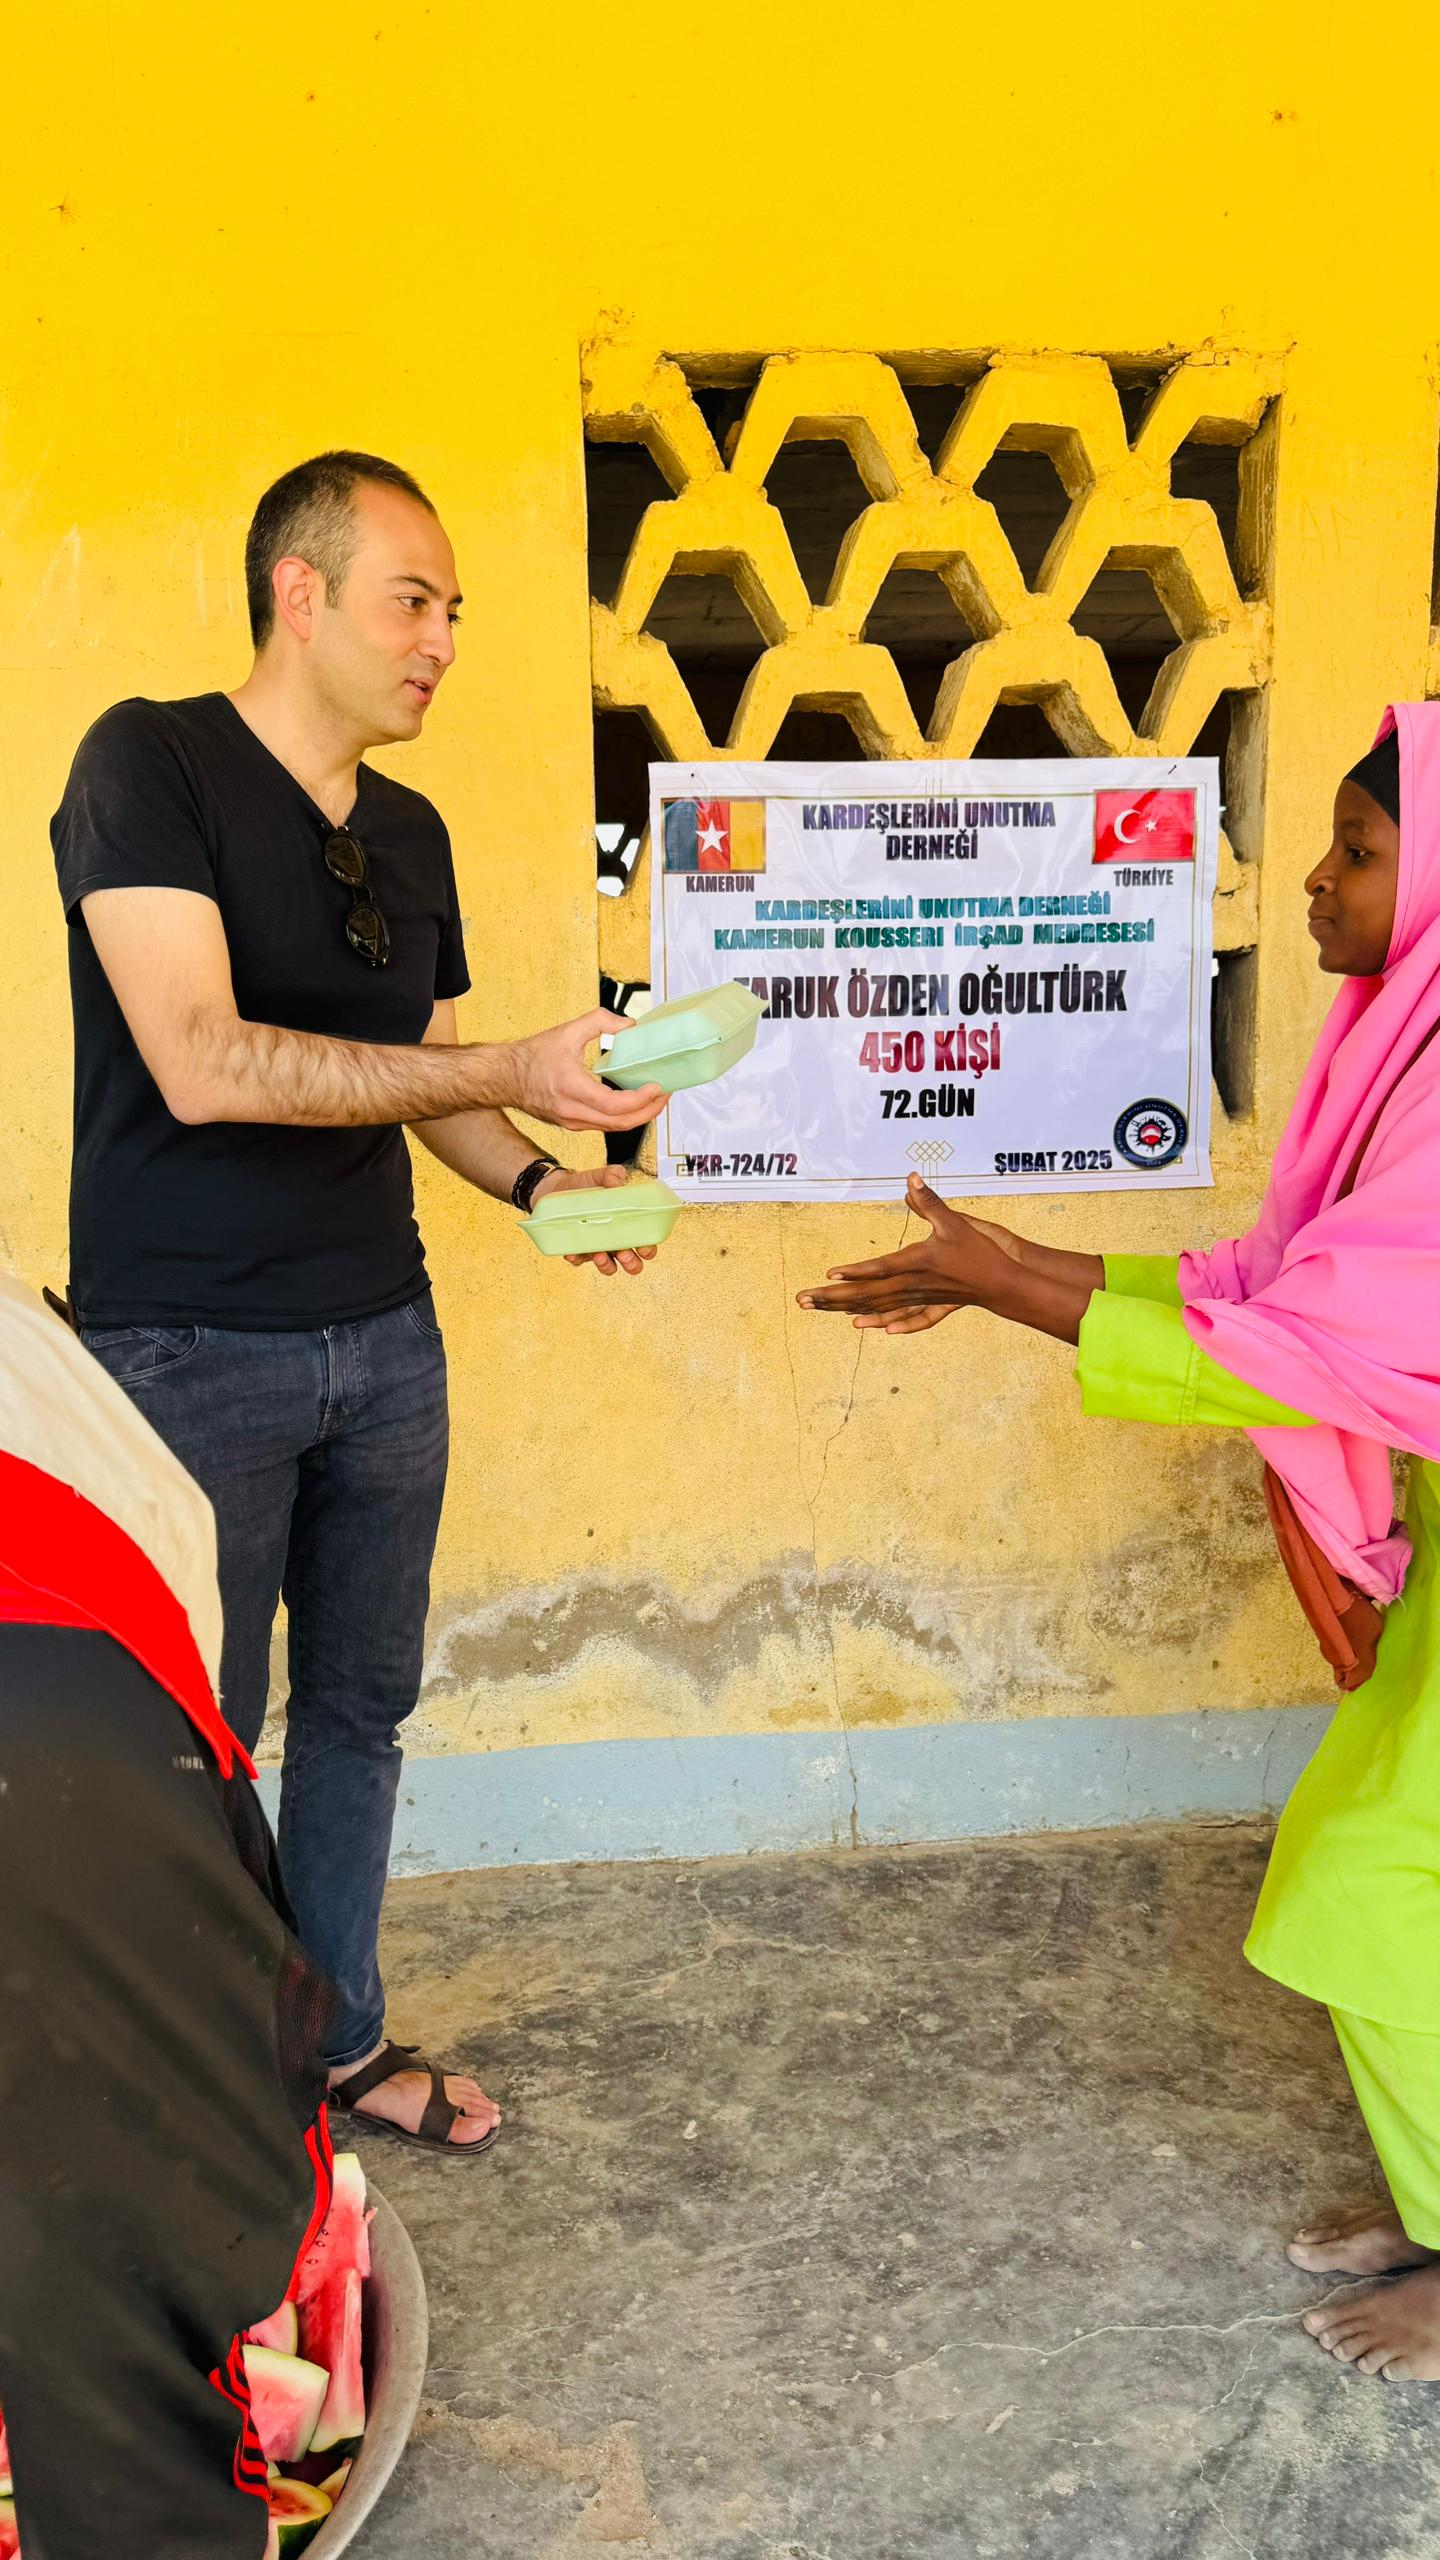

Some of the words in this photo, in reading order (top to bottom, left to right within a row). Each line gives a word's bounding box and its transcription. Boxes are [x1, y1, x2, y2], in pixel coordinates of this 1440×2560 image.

[802, 798, 958, 834] KARDEŞLERİNİ
[964, 802, 1056, 828] UNUTMA
[886, 829, 978, 860] DERNEĞİ
[686, 876, 755, 892] KAMERUN
[1113, 867, 1174, 887] TÜRKİYE
[755, 894, 913, 924] KARDEŞLERİNİ
[918, 896, 1015, 920] UNUTMA
[1018, 890, 1111, 917] DERNEĞİ
[714, 927, 824, 950] KAMERUN
[835, 926, 944, 949] KOUSSERI
[954, 922, 1023, 949] İRŞAD
[1033, 918, 1155, 944] MEDRESESİ
[847, 968, 950, 1018] ÖZDEN
[959, 963, 1127, 1017] OĞULTÜRK
[859, 1030, 925, 1073] 450
[934, 1022, 1001, 1079] KİŞİ
[880, 1083, 975, 1119] 72.GÜN
[684, 1152, 797, 1177] YKR-724/72
[994, 1151, 1057, 1176] ŞUBAT
[1061, 1150, 1112, 1171] 2025
